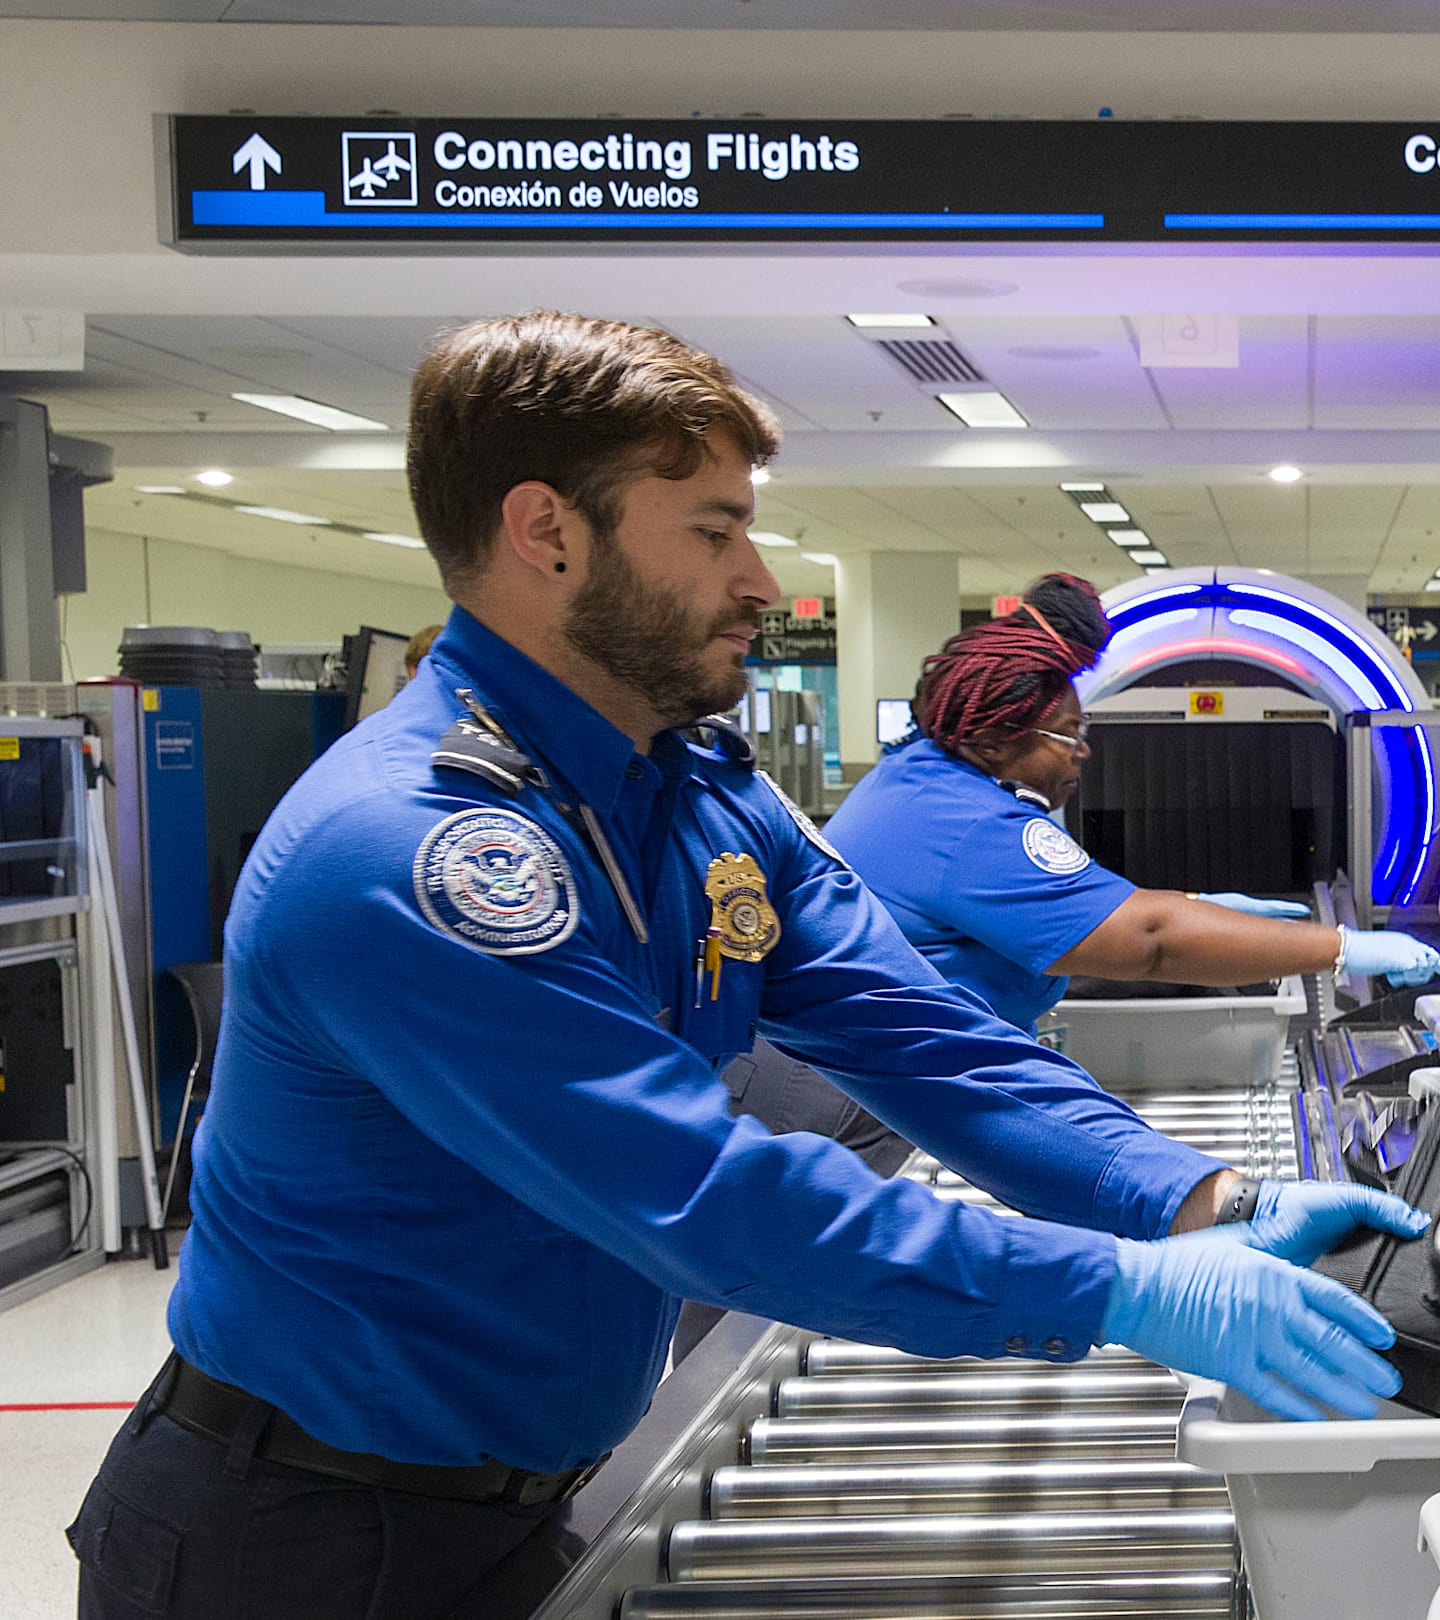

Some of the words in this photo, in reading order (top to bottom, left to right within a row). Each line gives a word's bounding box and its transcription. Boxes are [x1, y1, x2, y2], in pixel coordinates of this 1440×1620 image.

[434, 131, 691, 180] Connecting
[707, 133, 860, 180] Flights
[434, 180, 562, 208] Conexión
[568, 181, 603, 208] de
[609, 181, 699, 208] Vuelos
[796, 598, 819, 616] EXIT
